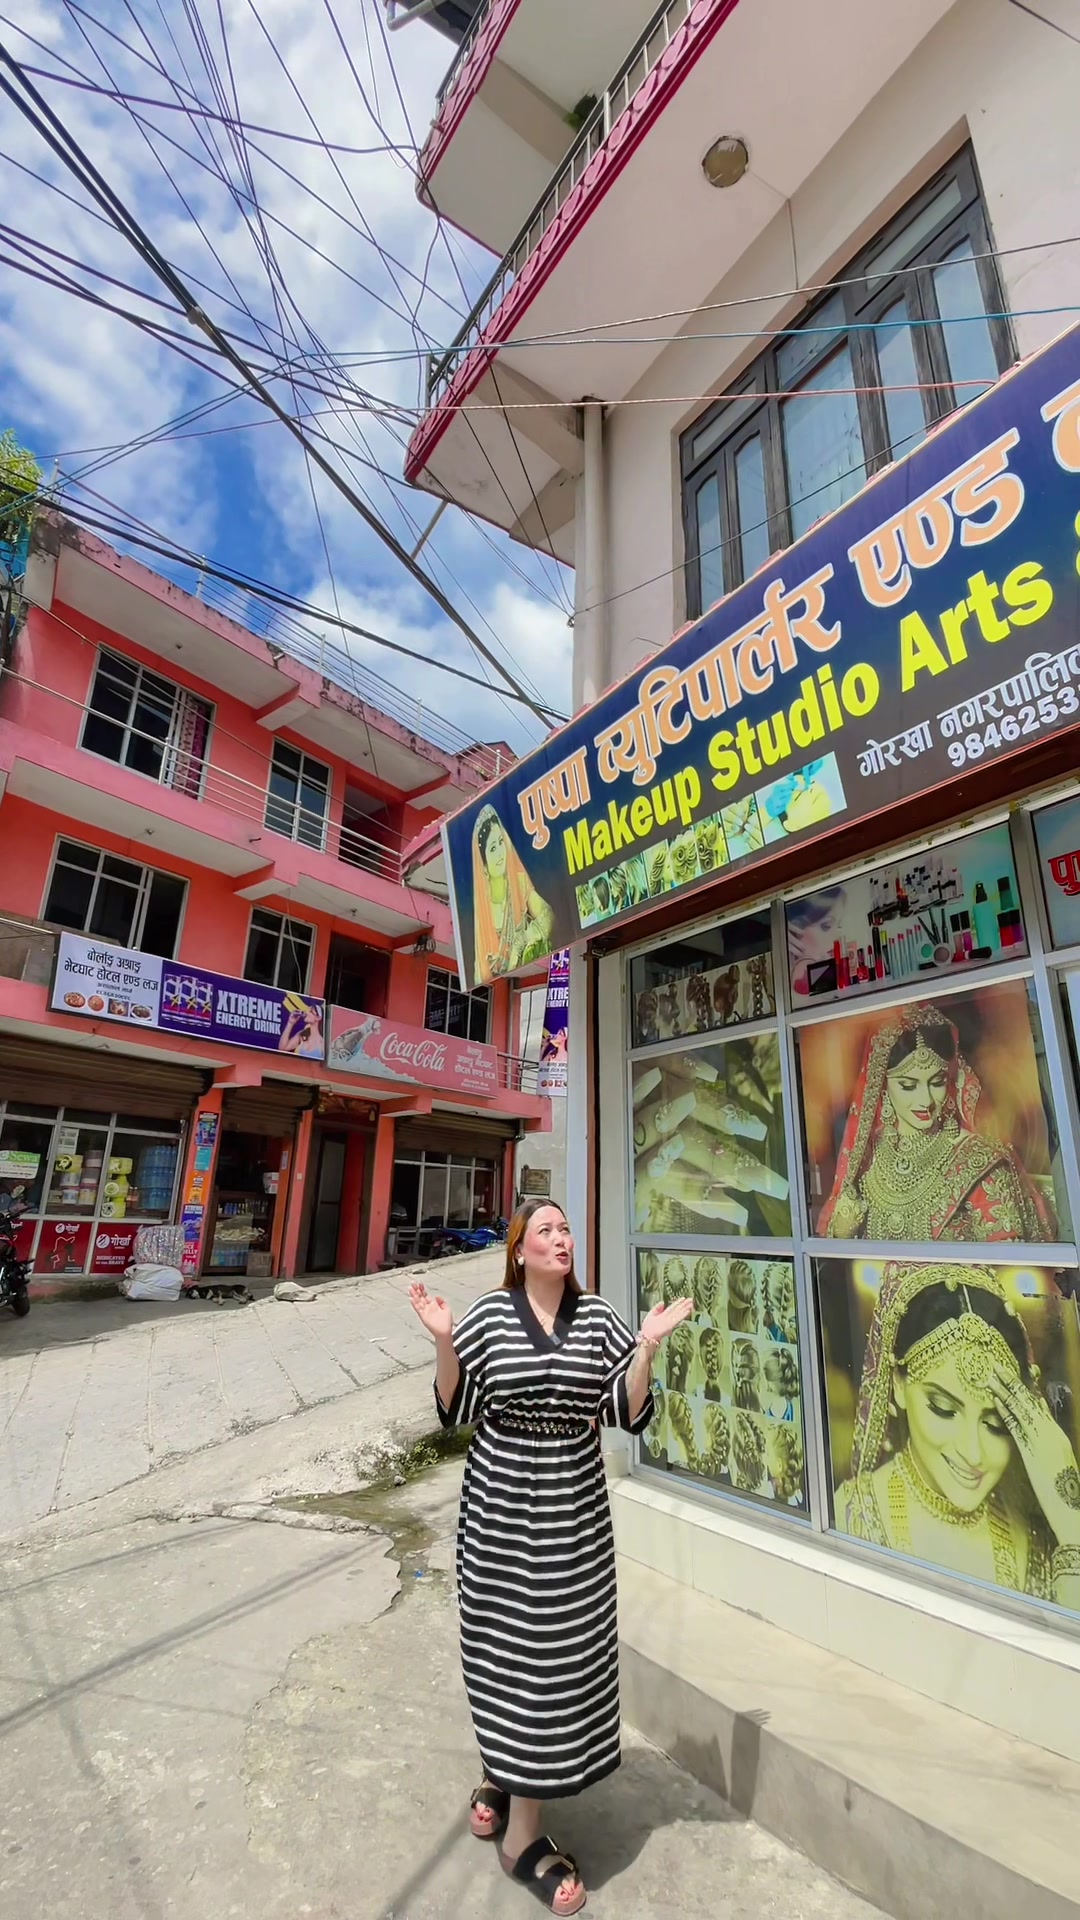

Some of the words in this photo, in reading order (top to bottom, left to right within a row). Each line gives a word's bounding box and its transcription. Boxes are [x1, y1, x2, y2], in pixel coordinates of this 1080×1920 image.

[848, 427, 1025, 607] एण्ड
[563, 765, 701, 876] Makeup
[707, 662, 880, 792] Studio
[900, 561, 1053, 693] Arts
[948, 684, 1080, 768] 9846253
[857, 720, 933, 777] गोरखा
[96, 965, 120, 983] होटल
[123, 974, 141, 987] एण्ड
[142, 978, 159, 991] लज
[548, 987, 569, 1000] XTRE
[216, 1012, 253, 1030] ENERGY
[254, 1019, 281, 1035] DRINK
[217, 990, 282, 1022] XTREME
[380, 1032, 448, 1072] Coca-Cola
[110, 1233, 132, 1247] गोर्खा
